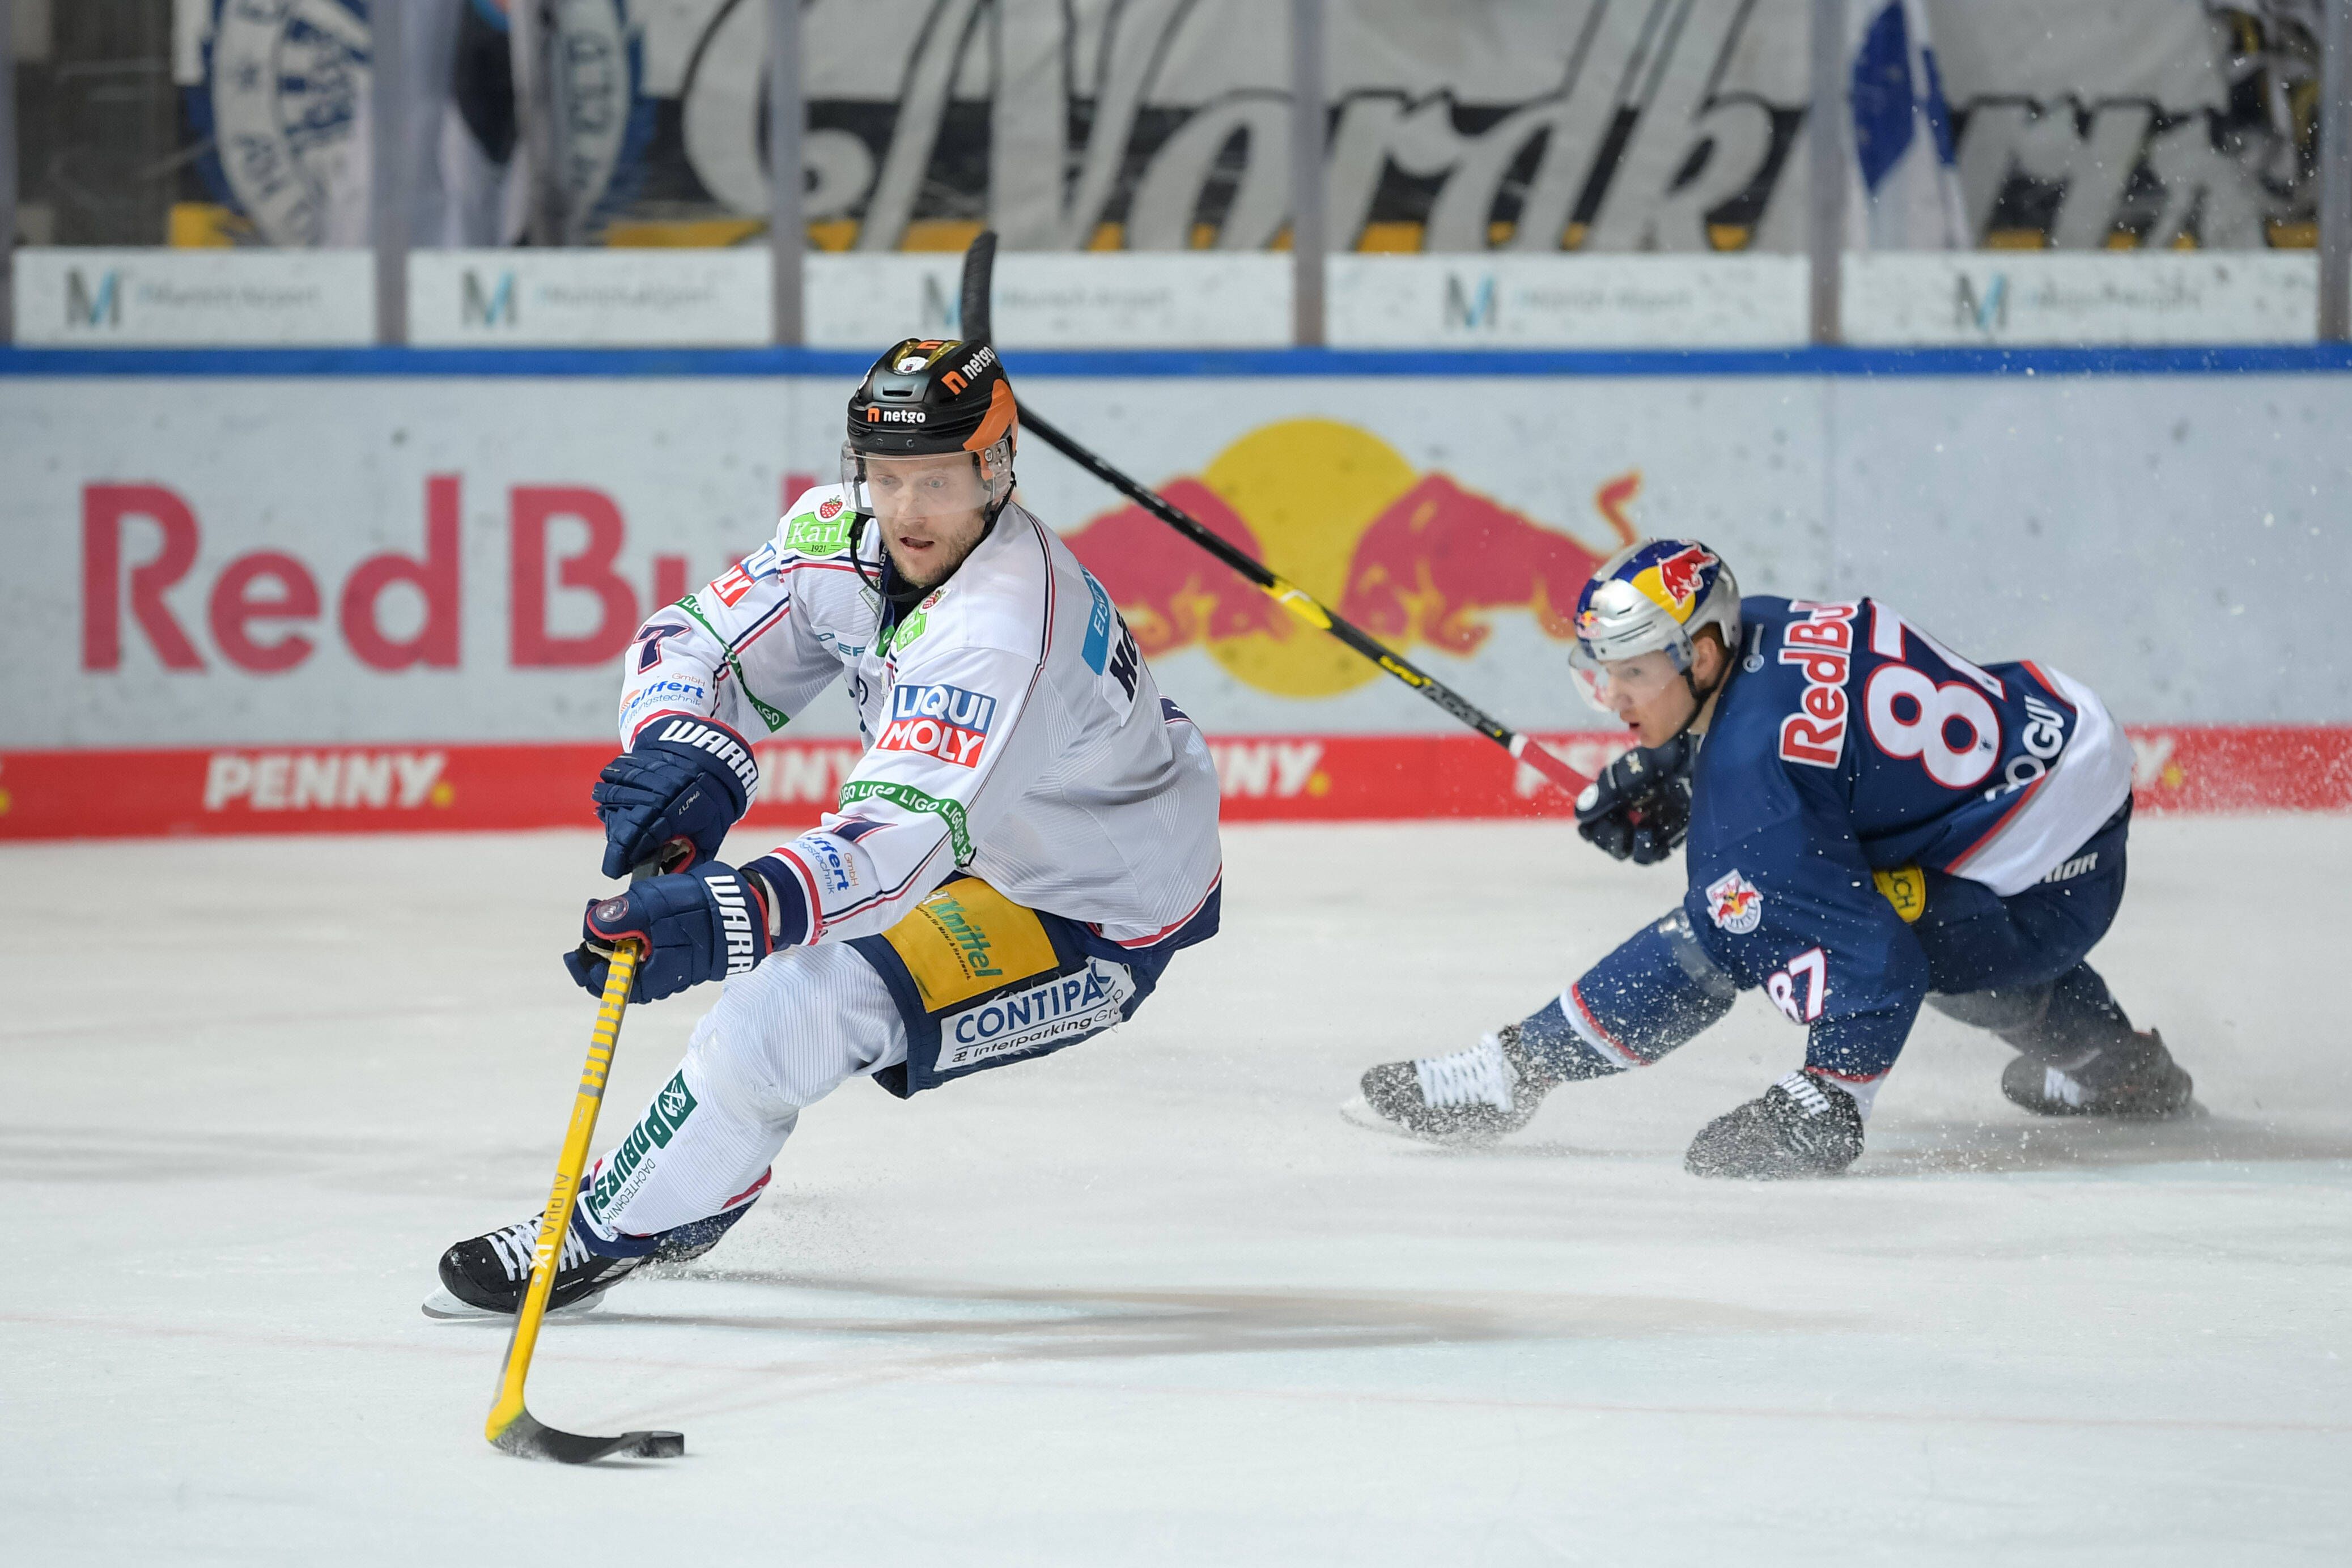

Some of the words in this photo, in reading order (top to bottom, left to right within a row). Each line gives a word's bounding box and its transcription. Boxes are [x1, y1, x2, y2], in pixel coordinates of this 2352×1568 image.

[961, 345, 996, 380] netgo
[883, 410, 926, 423] netgo
[811, 544, 826, 553] 1921
[82, 471, 462, 673] Red
[633, 623, 691, 675] 7
[672, 673, 706, 687] GmbH
[1863, 598, 2009, 790] 87
[896, 686, 991, 730] LIQUI
[1778, 648, 1849, 770] Red
[881, 720, 984, 763] MOLY
[899, 789, 940, 811] LIGO
[941, 801, 963, 830] LIGO
[843, 852, 859, 886] GmbH
[928, 900, 1003, 977] Knittel
[540, 1173, 571, 1236] ALPHA
[602, 1158, 656, 1224] DACHTECHNIK
